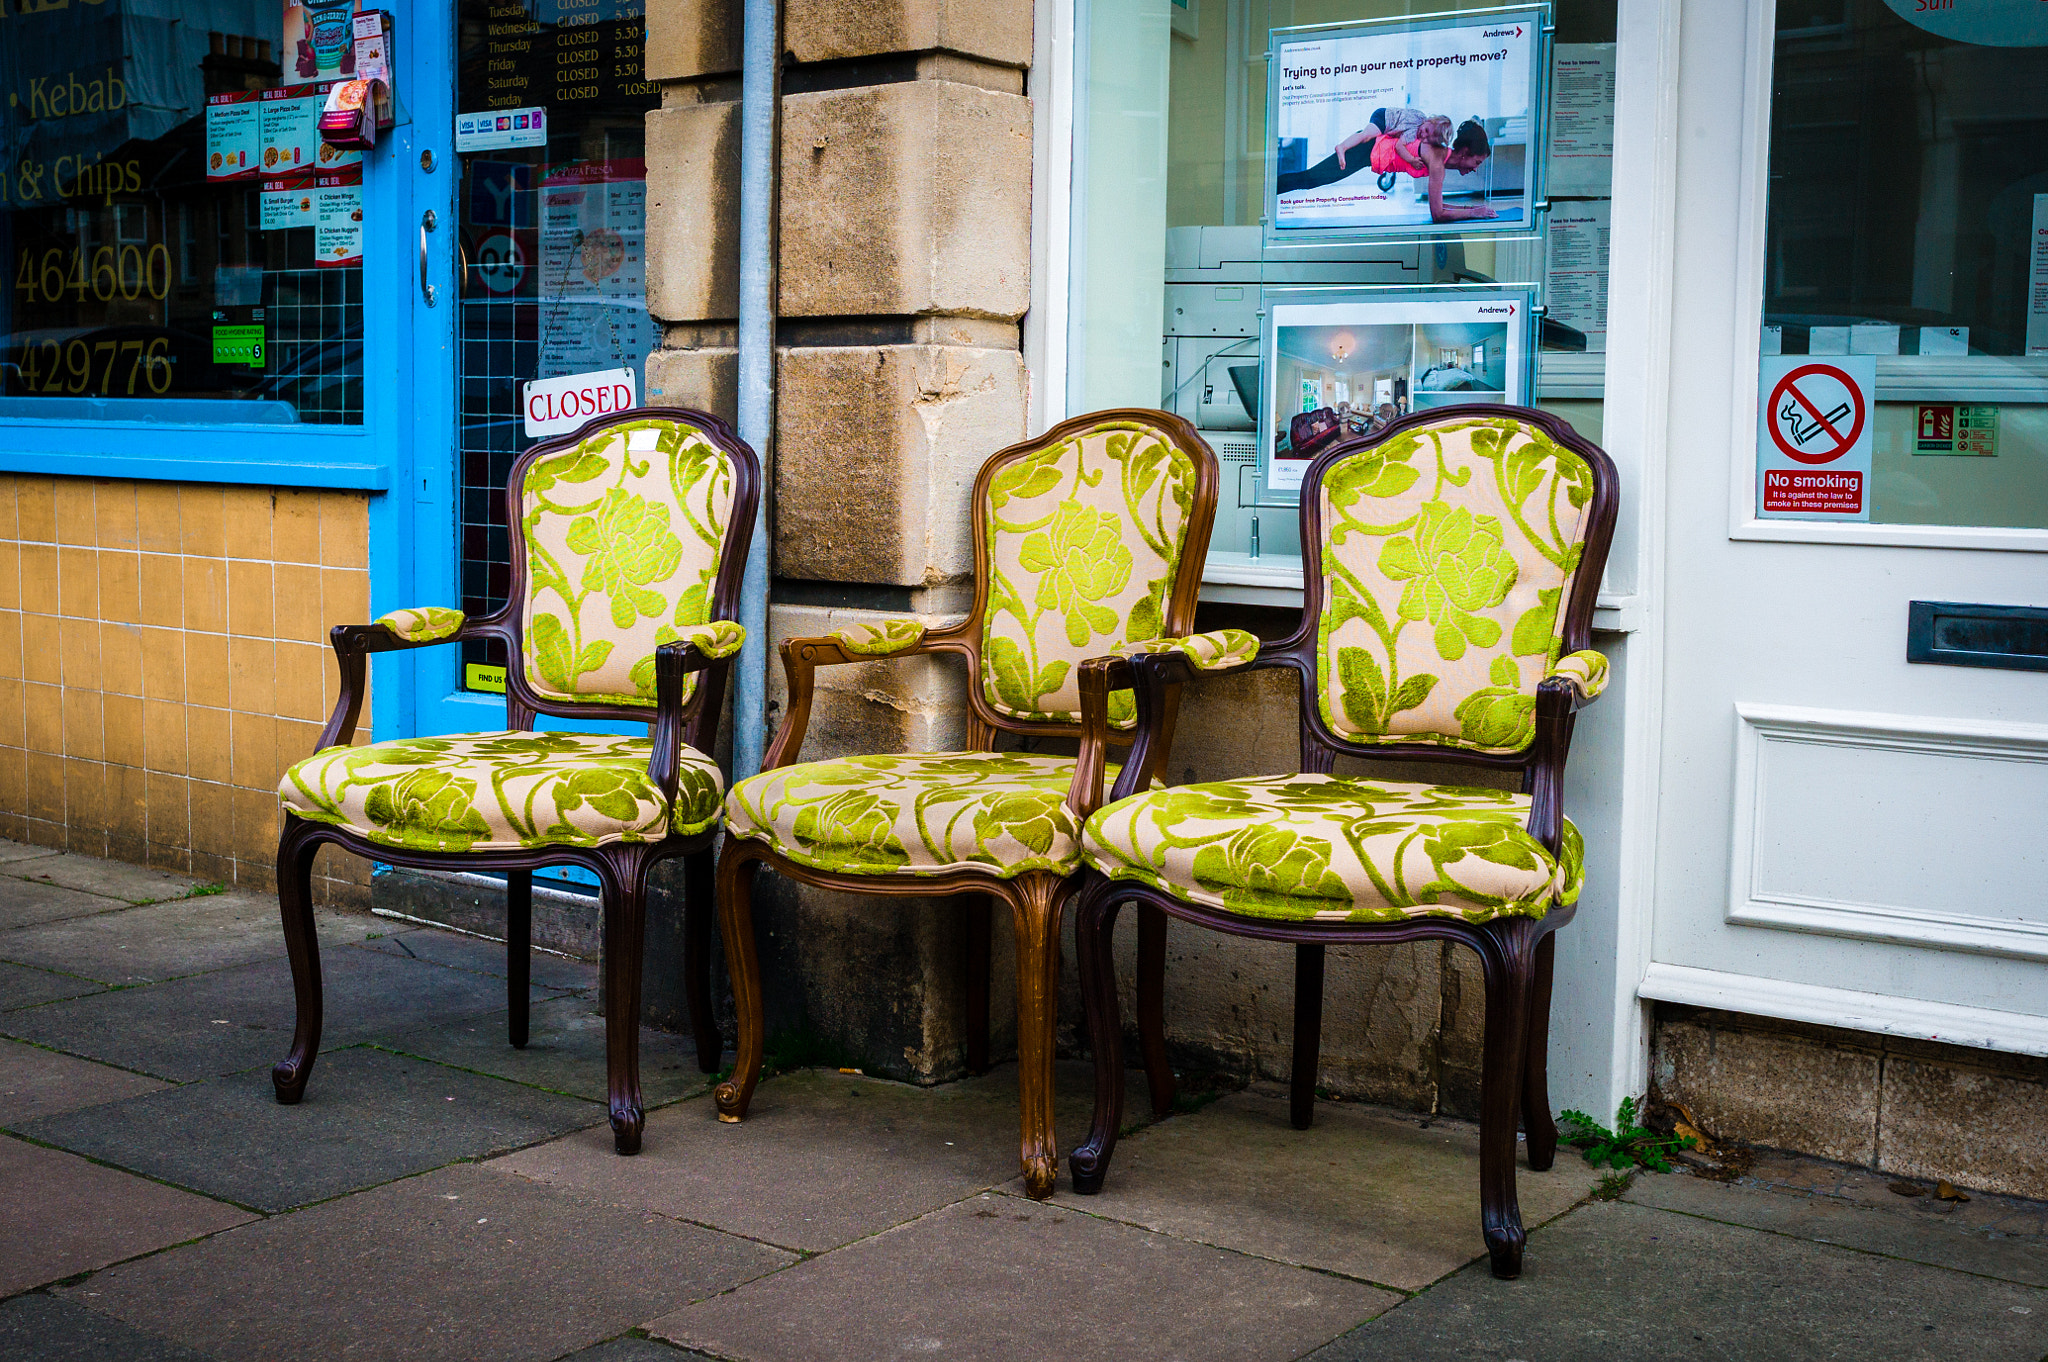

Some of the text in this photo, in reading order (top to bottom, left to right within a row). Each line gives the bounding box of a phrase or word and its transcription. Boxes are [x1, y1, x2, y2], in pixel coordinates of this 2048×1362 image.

[489, 5, 526, 18] Tuesday
[488, 8, 638, 36] Wednesday CLOSED 5.30
[488, 26, 638, 54] Thursday CLOSED 5.30
[1482, 29, 1514, 38] Andrews
[488, 45, 638, 72] Friday CLOSED 5.30
[1284, 49, 1508, 80] Trying to plan your next property move?
[488, 63, 638, 90] Saturday CLOSED 5.30
[30, 67, 126, 119] Kebab
[263, 90, 274, 99] MEAL
[274, 90, 282, 98] DEAL
[488, 82, 662, 108] Sunday CLOSED LOSED
[268, 106, 279, 114] Large
[291, 104, 300, 112] Deal
[462, 121, 474, 129] VISA
[480, 120, 492, 128] VISA
[564, 166, 583, 176] PIZZA
[18, 160, 44, 200] &
[54, 152, 141, 206] Chips
[320, 178, 329, 186] MEAL
[264, 182, 284, 190] MEAL DEAL
[16, 244, 172, 302] 464600
[1478, 306, 1508, 314] Andrews
[255, 345, 260, 358] 5
[17, 336, 172, 394] 429776
[528, 384, 632, 422] CLOSED
[1768, 474, 1858, 492] No smoking
[1788, 492, 1815, 500] against
[1845, 492, 1852, 500] to
[479, 674, 492, 682] FIND
